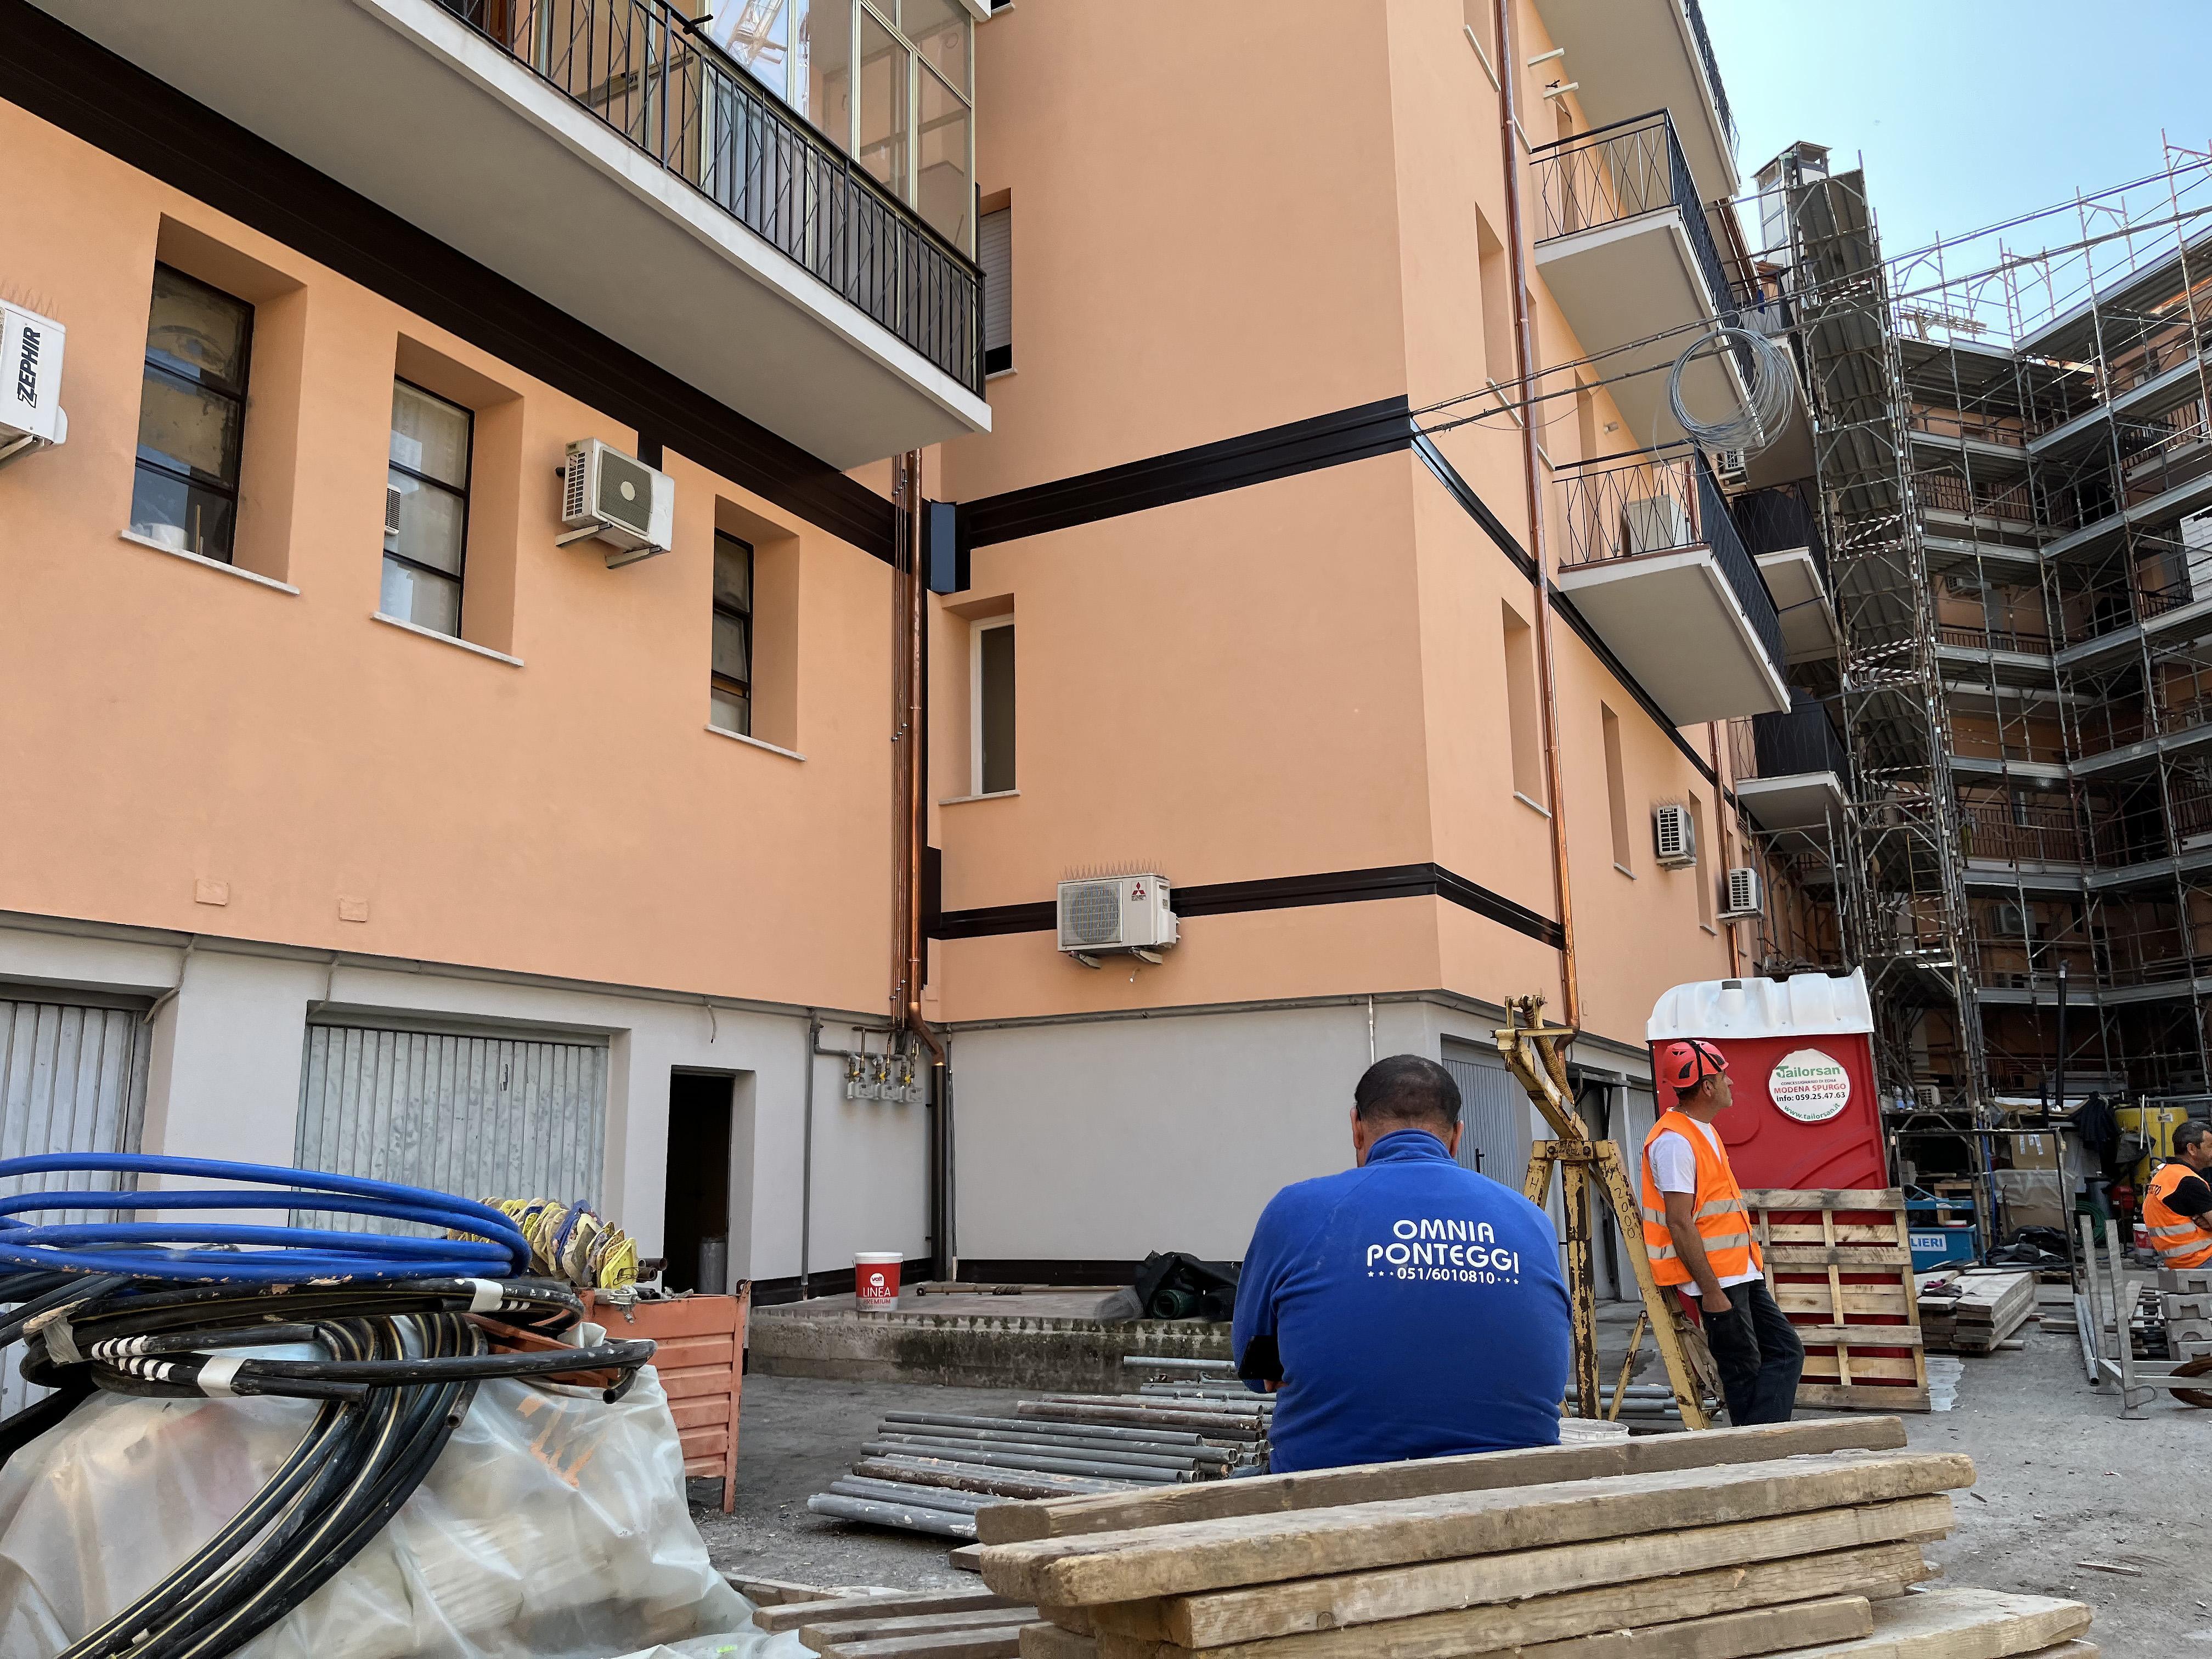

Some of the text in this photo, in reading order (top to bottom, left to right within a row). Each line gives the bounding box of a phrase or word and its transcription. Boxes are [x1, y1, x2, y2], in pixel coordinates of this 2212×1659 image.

[17, 326, 41, 408] ZEPHIR
[1775, 1065, 1840, 1078] Tailorsan
[1774, 1084, 1846, 1094] MODENA SPURGO
[1795, 1092, 1846, 1101] 059.25.47.63
[1784, 1103, 1840, 1120] www.tailorsan.it
[1393, 1218, 1495, 1244] OMNIA
[1367, 1242, 1519, 1274] PONTEGGI
[1397, 1267, 1495, 1284] 051/6010810
[862, 1286, 891, 1297] LINEA
